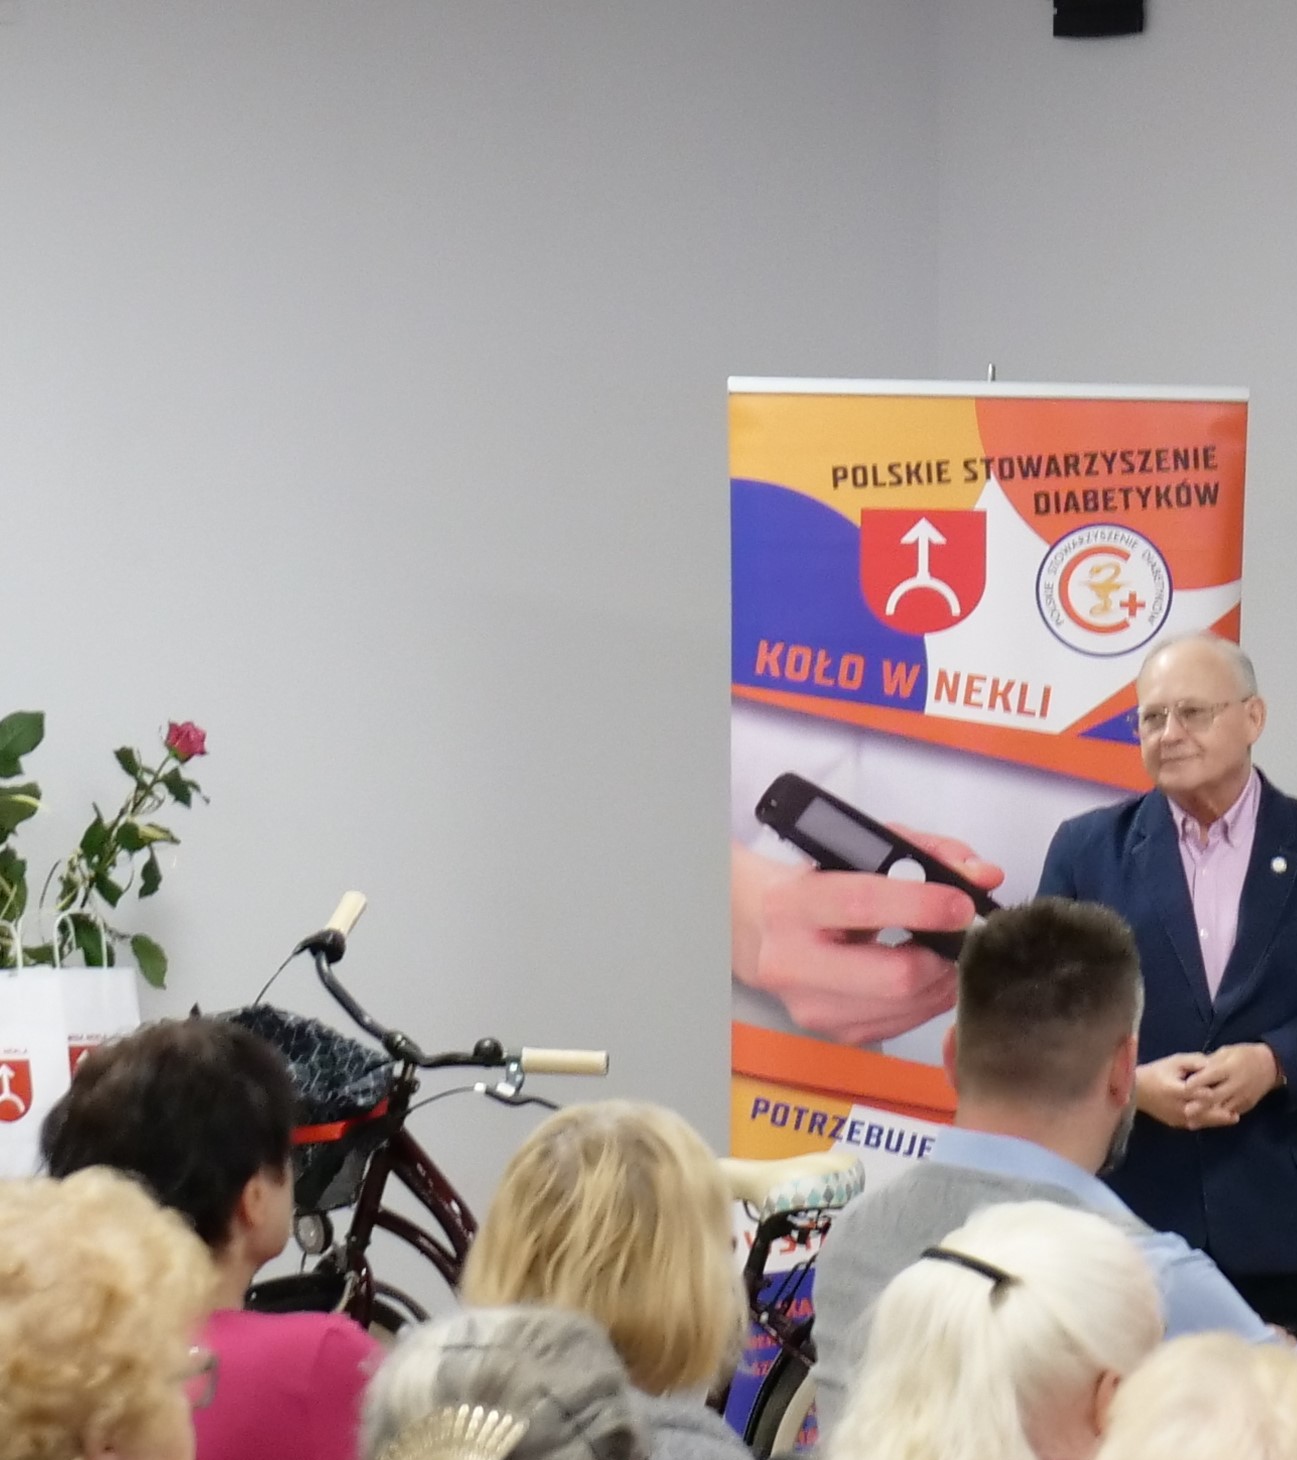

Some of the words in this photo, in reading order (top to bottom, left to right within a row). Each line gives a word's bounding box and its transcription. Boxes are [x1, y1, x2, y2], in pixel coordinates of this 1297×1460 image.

[831, 458, 952, 490] POLSKIE
[963, 445, 1218, 483] STOWARZYSZENIE
[1033, 479, 1219, 516] DIABETYKÓW
[755, 639, 866, 691] KOŁO
[881, 658, 921, 699] W
[933, 667, 1052, 720] NEKLI
